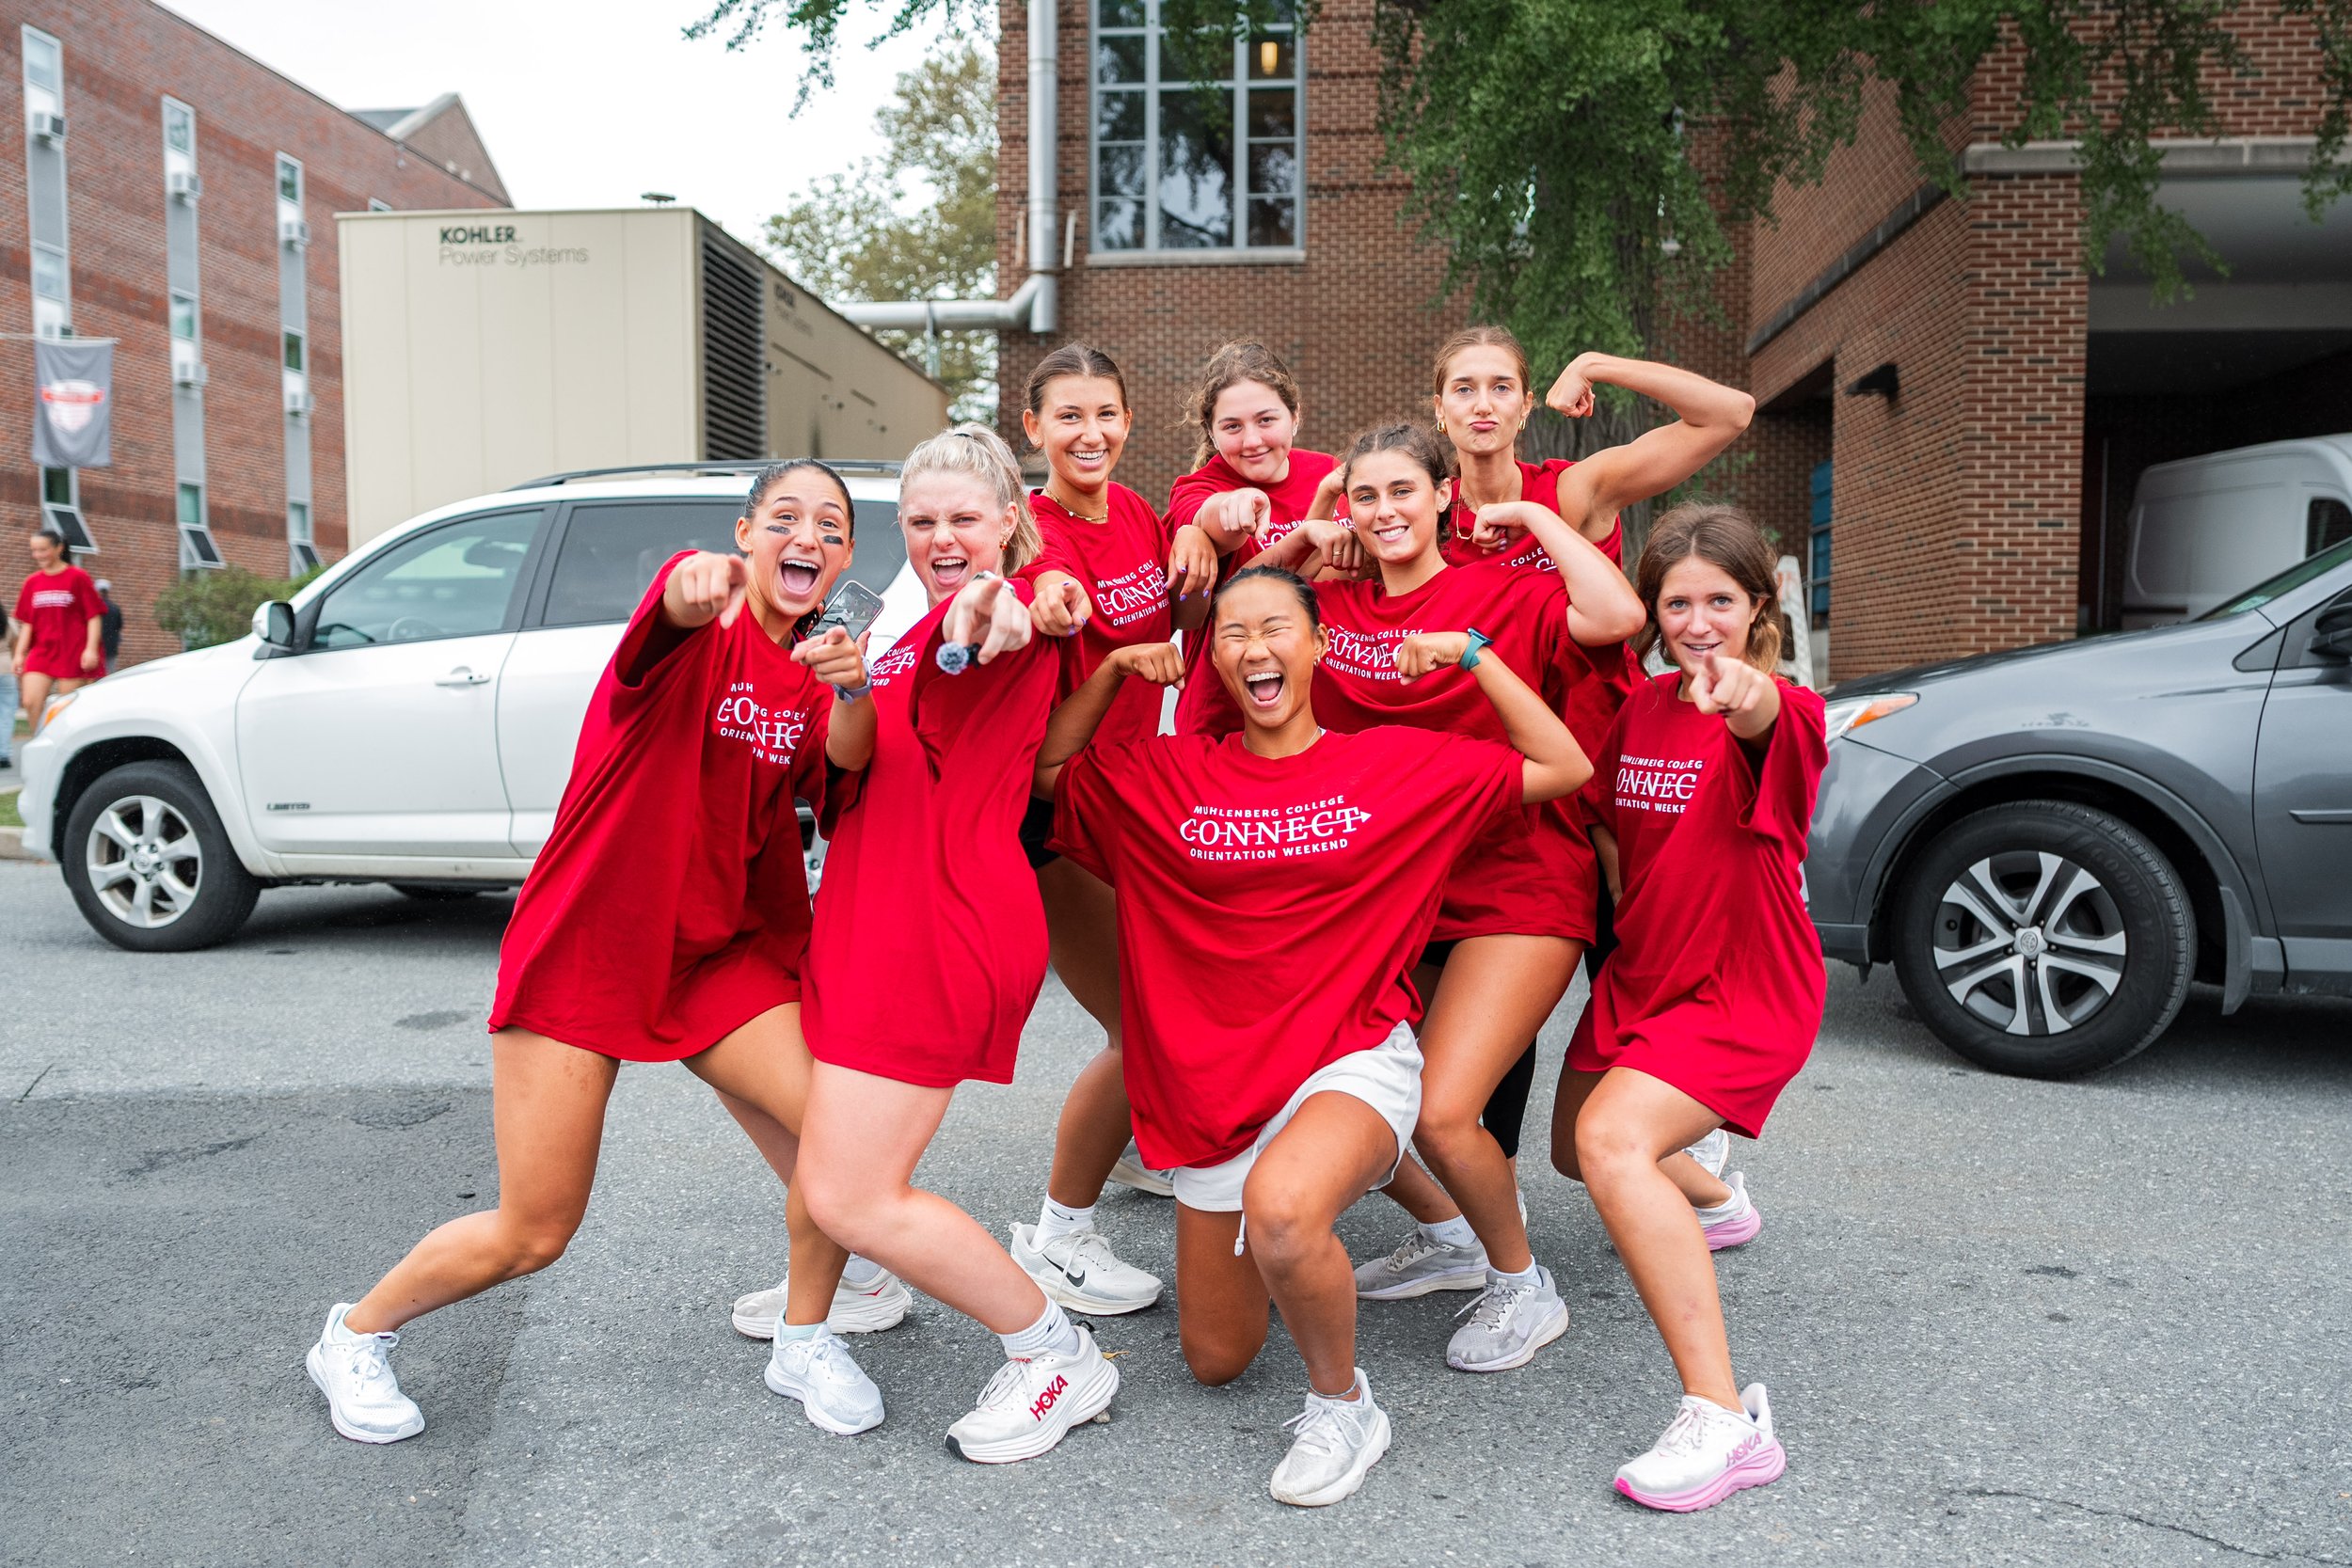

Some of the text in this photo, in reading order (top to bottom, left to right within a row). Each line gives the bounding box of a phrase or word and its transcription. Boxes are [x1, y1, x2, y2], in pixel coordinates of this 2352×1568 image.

[439, 226, 517, 245] KOHLER
[439, 244, 590, 268] Power Systems
[1511, 546, 1544, 567] COLLE
[1096, 566, 1168, 615] CONNEC
[1377, 628, 1422, 641] COLLEG
[1325, 657, 1403, 680] ORIENTATION WEEKE
[1666, 759, 1704, 769] COLLEG
[1616, 768, 1697, 800] ONNEC
[1193, 795, 1344, 818] MUHLENBERG COLLEGE
[1654, 802, 1687, 814] WEEKE
[1180, 806, 1364, 847] CONNECT
[1189, 838, 1349, 861] ORIENTATION WEEKEND
[1029, 1374, 1069, 1422] HOKA
[1725, 1431, 1762, 1468] HOKA
